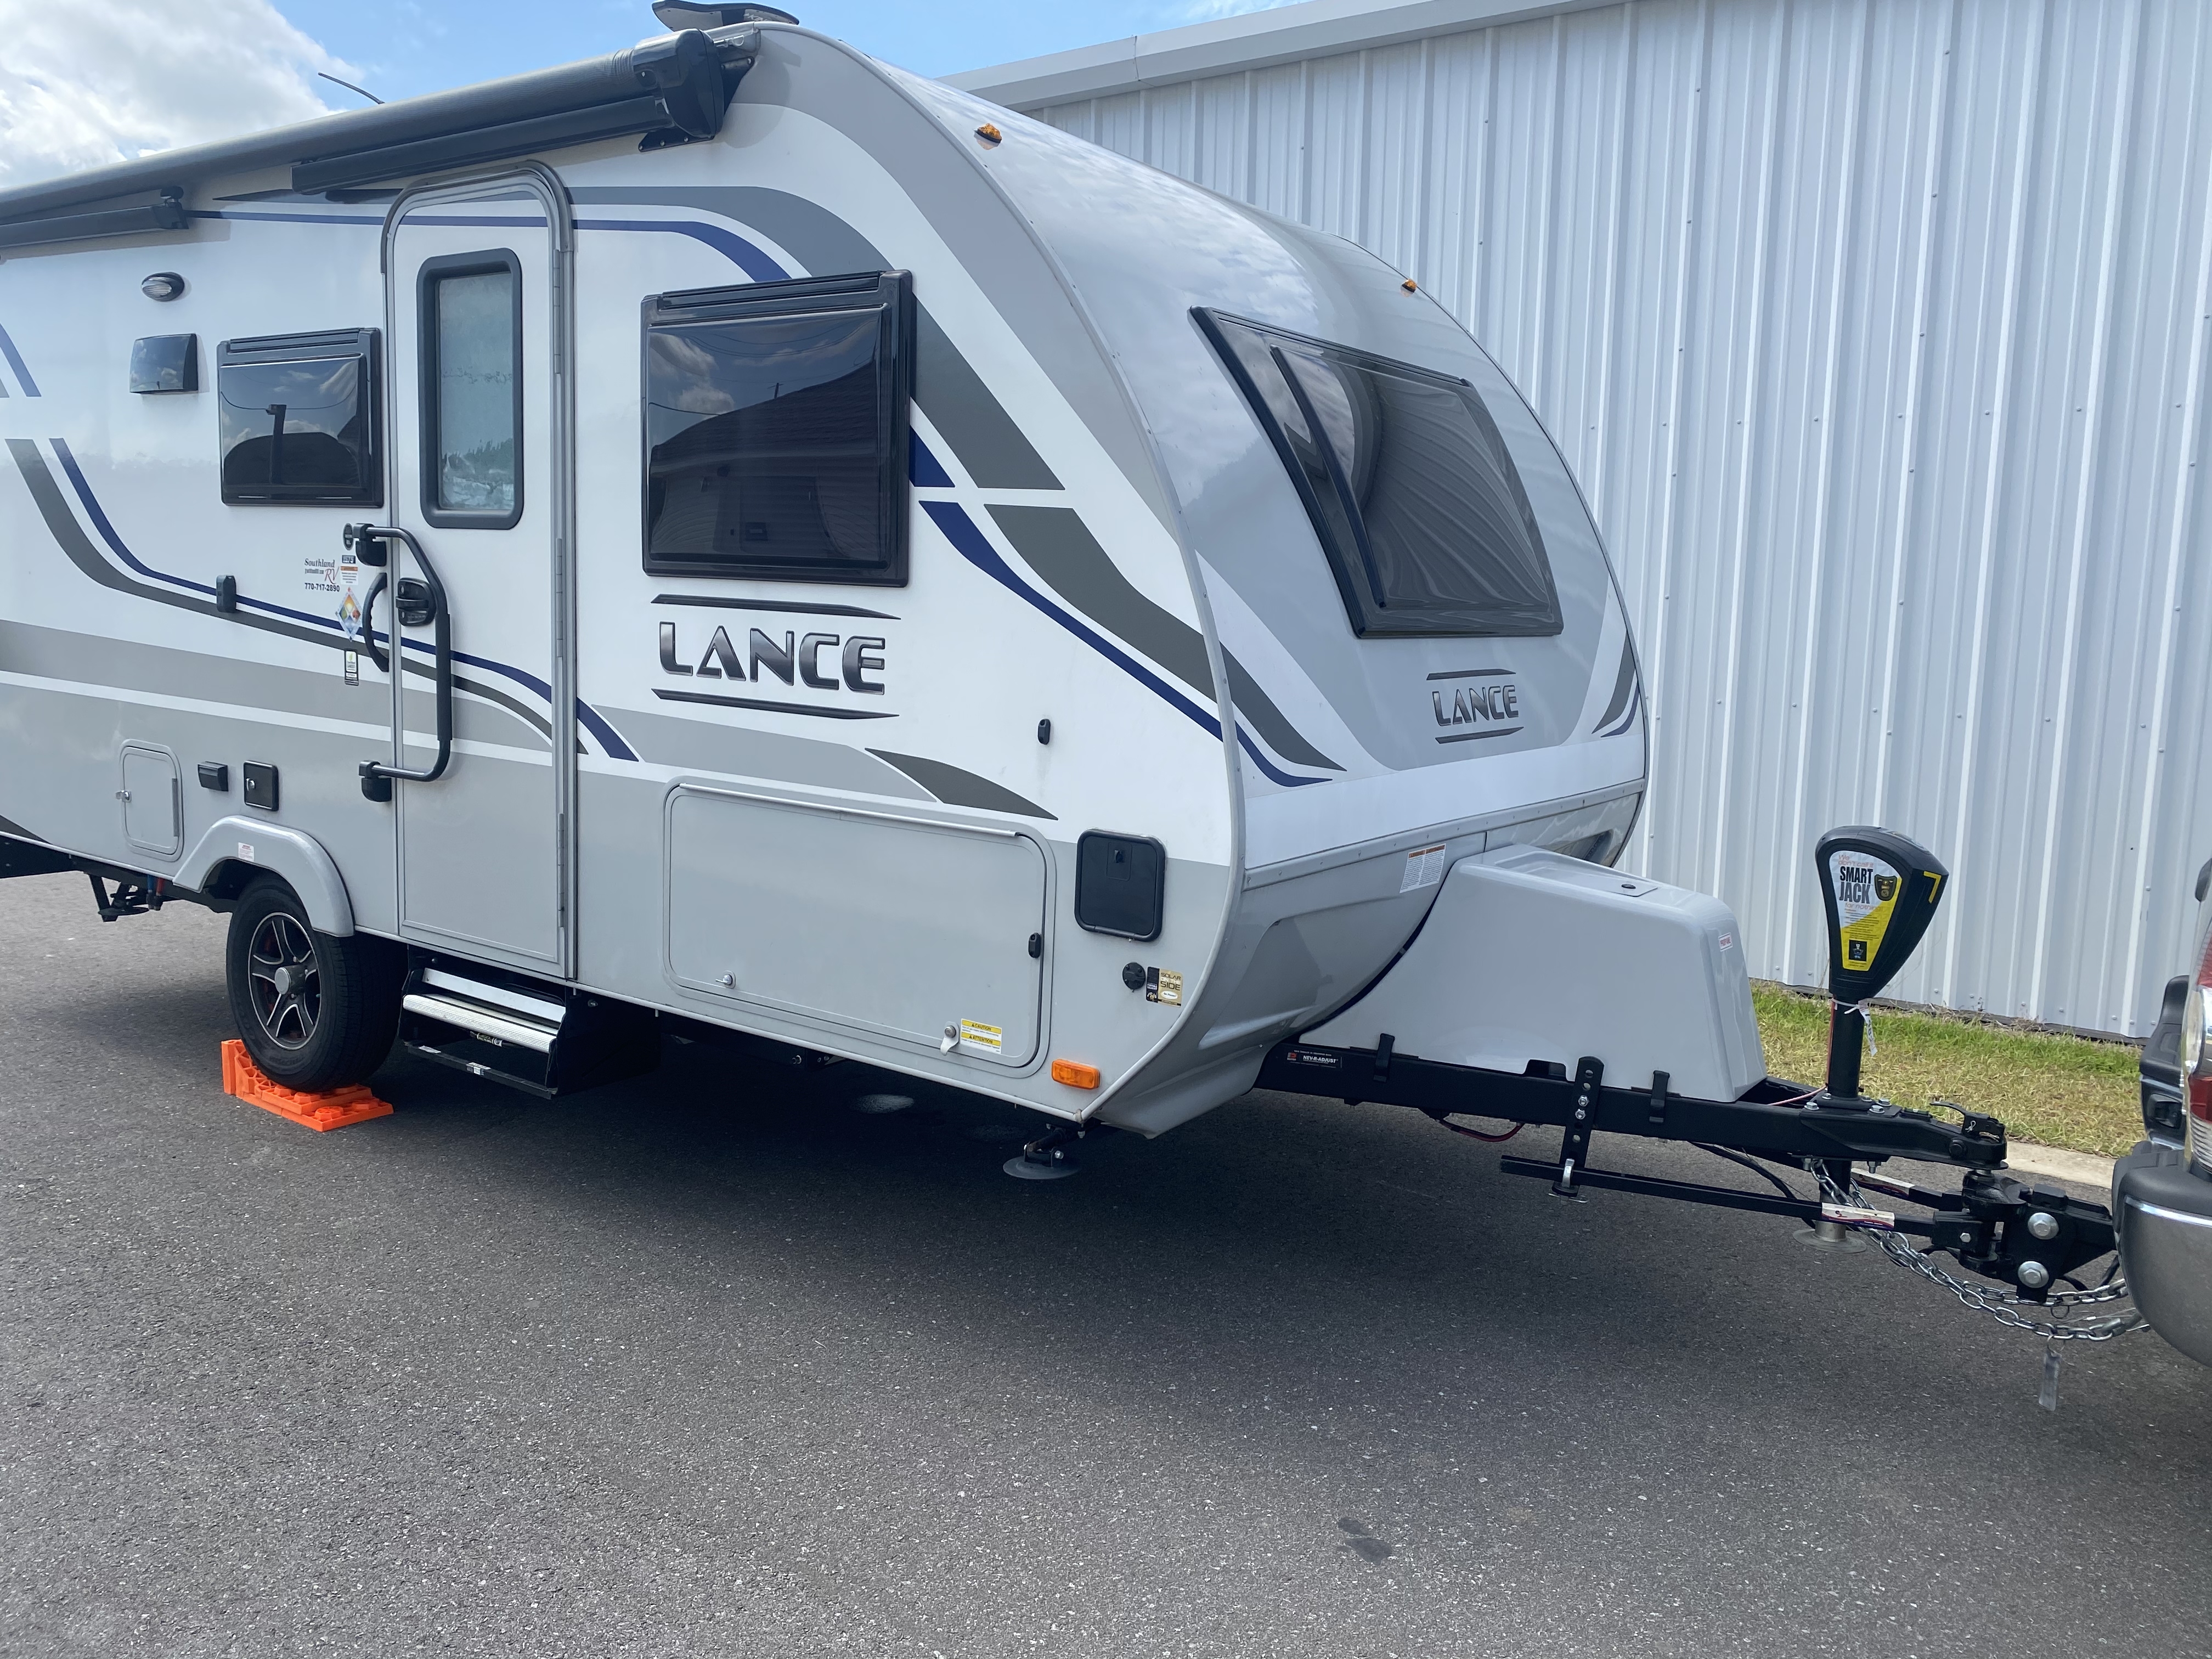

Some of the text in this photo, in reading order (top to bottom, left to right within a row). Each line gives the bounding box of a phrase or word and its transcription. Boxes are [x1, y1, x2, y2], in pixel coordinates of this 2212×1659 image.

[304, 558, 335, 568] Southland
[324, 566, 340, 585] RV
[304, 582, 340, 592] 770-717-2890
[659, 621, 885, 696] LANCE
[1432, 685, 1519, 727] LANCE
[1839, 866, 1874, 884] SMART
[1839, 881, 1871, 904] JACK
[1160, 972, 1181, 981] SOLAR
[1160, 980, 1181, 991] SIDE
[974, 1023, 991, 1031] CAUTION
[973, 1035, 993, 1044] ATTENTION
